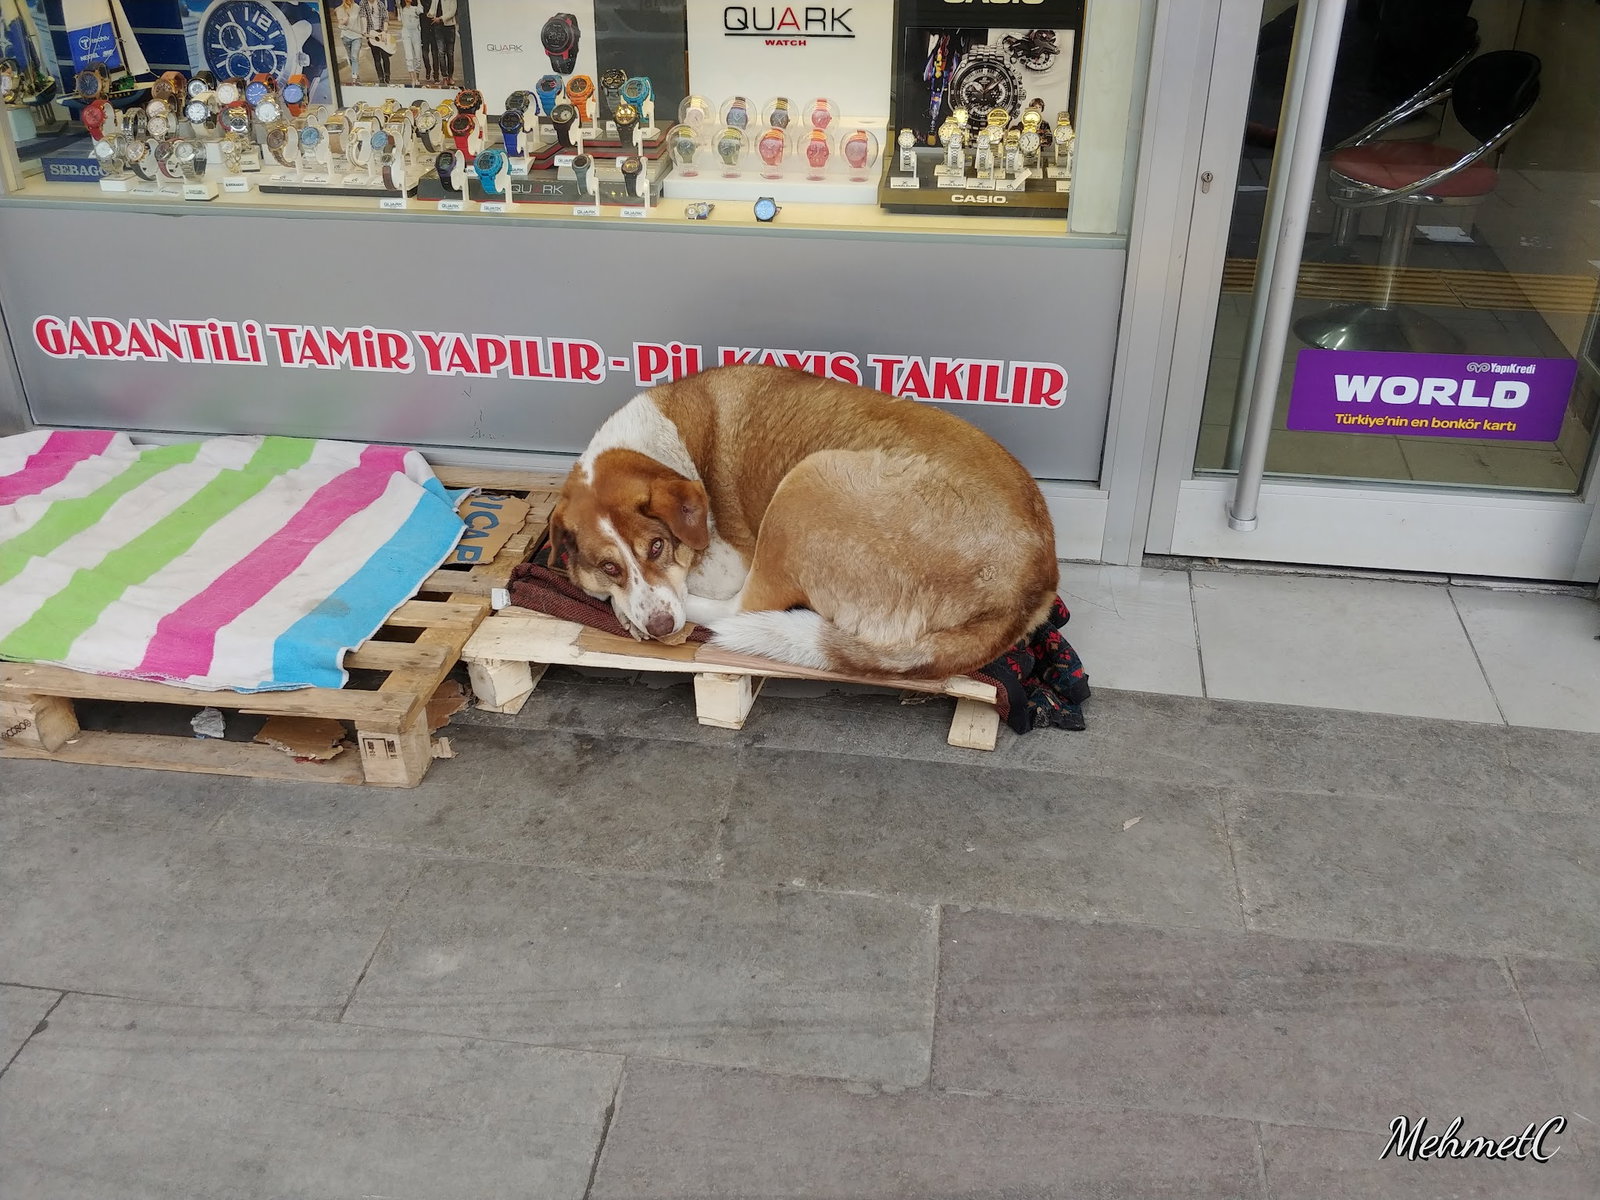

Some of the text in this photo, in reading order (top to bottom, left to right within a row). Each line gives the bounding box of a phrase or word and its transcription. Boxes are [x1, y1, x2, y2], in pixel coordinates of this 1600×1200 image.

[723, 6, 853, 32] QUARK
[486, 43, 524, 53] QUARK
[765, 39, 807, 47] WATCH
[511, 183, 564, 195] QUARK
[950, 194, 1008, 204] CASIO
[419, 334, 603, 382] YAPILIR
[871, 357, 1066, 408] TAKILIR
[1333, 374, 1531, 409] WORLD
[1411, 418, 1428, 428] en
[1431, 416, 1480, 431] bonkör
[1482, 420, 1517, 432] kartı
